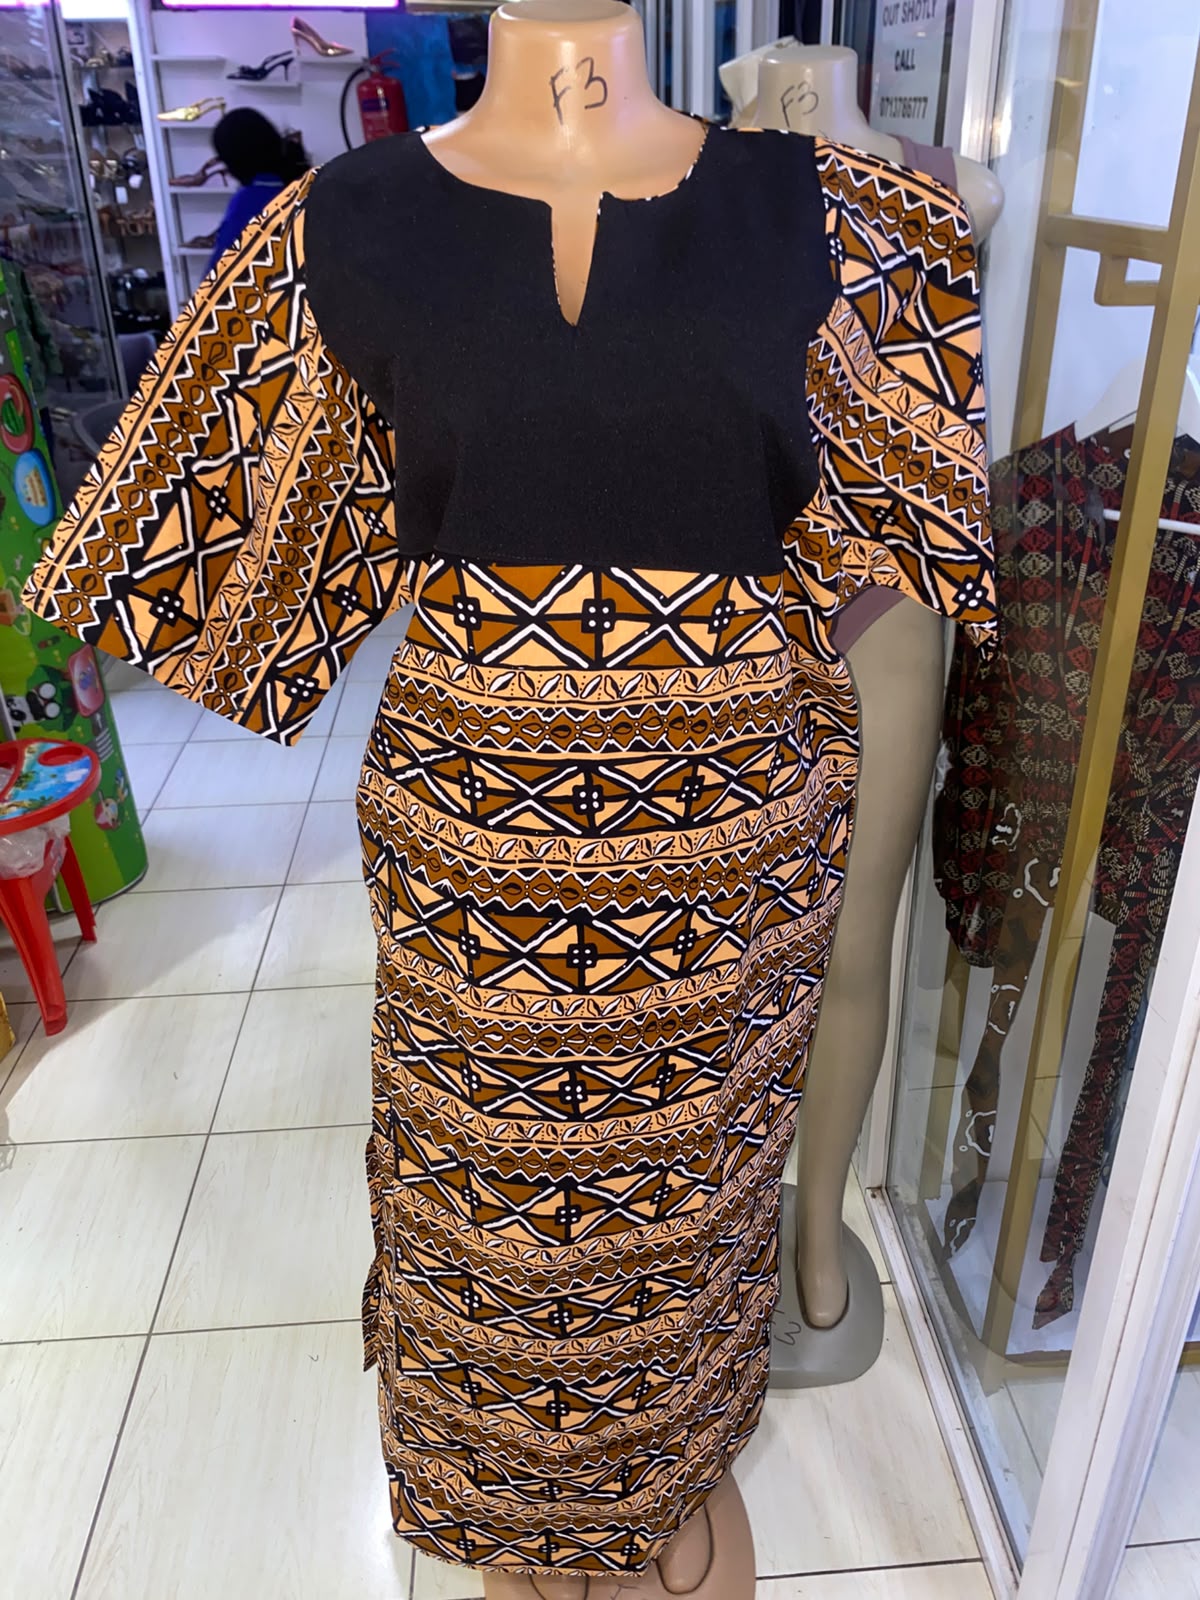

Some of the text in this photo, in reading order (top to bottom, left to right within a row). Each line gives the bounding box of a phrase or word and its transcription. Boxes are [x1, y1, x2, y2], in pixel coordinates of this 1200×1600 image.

[883, 2, 900, 27] OUT
[894, 48, 916, 72] CALL
[550, 57, 608, 125] F3
[780, 81, 820, 127] F3
